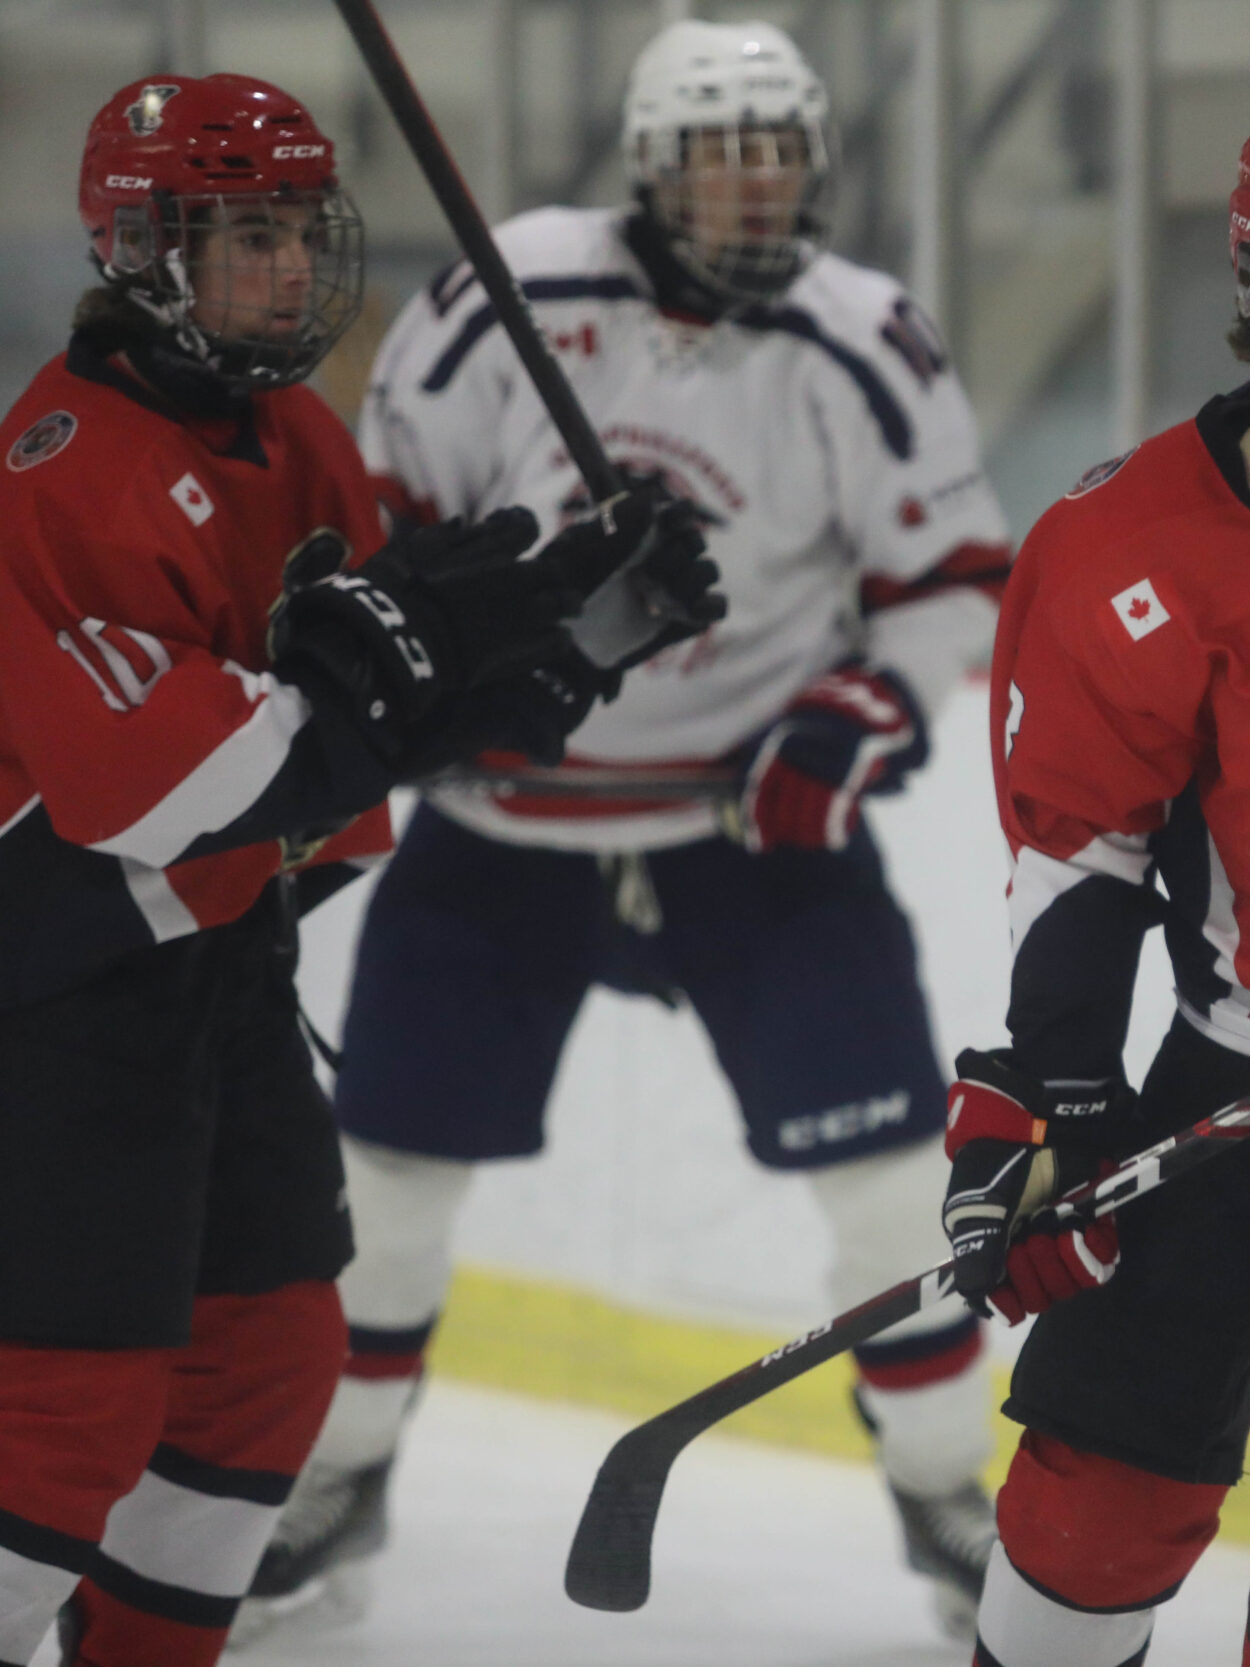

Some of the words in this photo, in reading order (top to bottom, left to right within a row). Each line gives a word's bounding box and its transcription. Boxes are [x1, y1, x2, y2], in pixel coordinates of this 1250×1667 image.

[272, 144, 325, 160] CCM
[105, 174, 153, 190] CCM
[56, 616, 174, 713] 10
[1054, 1101, 1108, 1117] CCM
[952, 1239, 985, 1258] CM
